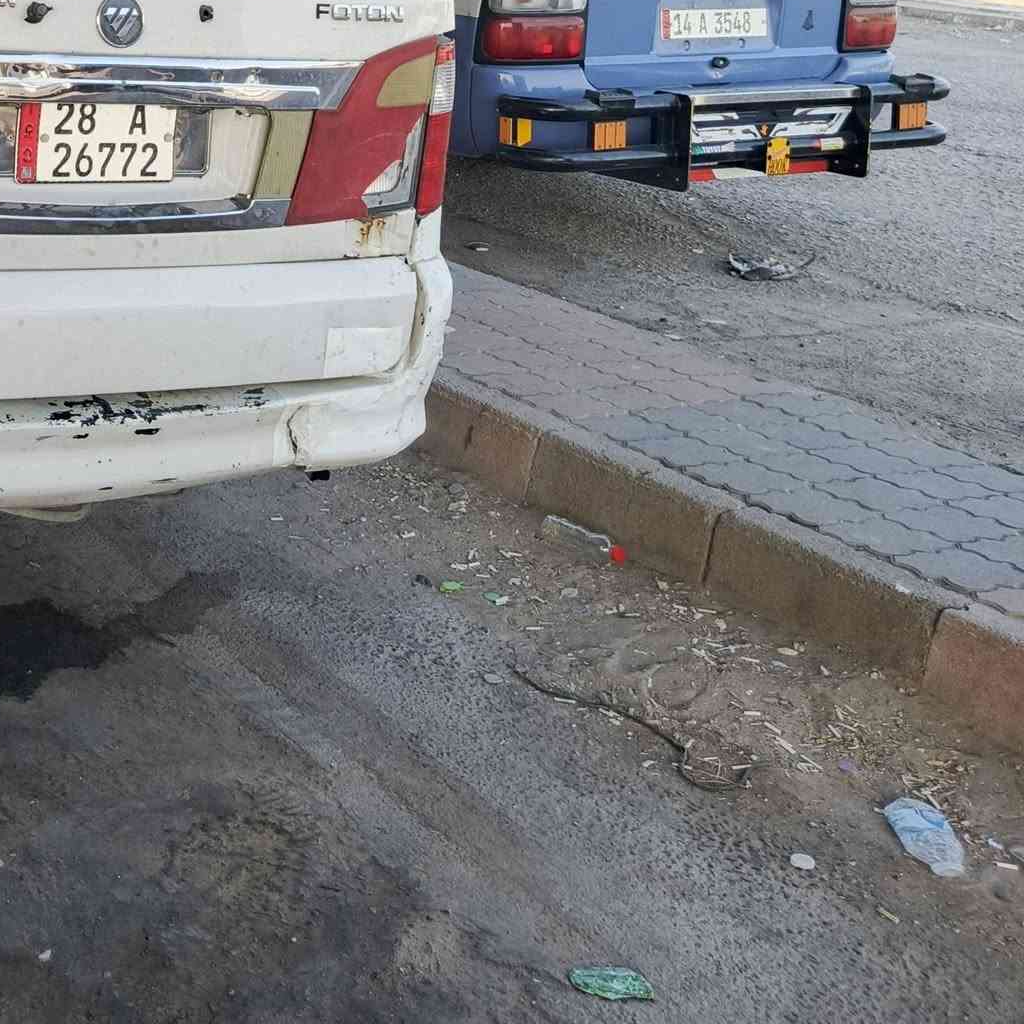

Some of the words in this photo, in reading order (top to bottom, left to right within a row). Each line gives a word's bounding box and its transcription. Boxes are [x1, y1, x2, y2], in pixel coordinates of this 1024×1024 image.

[316, 3, 405, 23] FOTON
[673, 13, 692, 35] 14
[699, 13, 708, 34] A
[714, 11, 752, 34] 3548
[54, 103, 97, 135] 28
[128, 104, 147, 135] A
[52, 142, 159, 177] 26772
